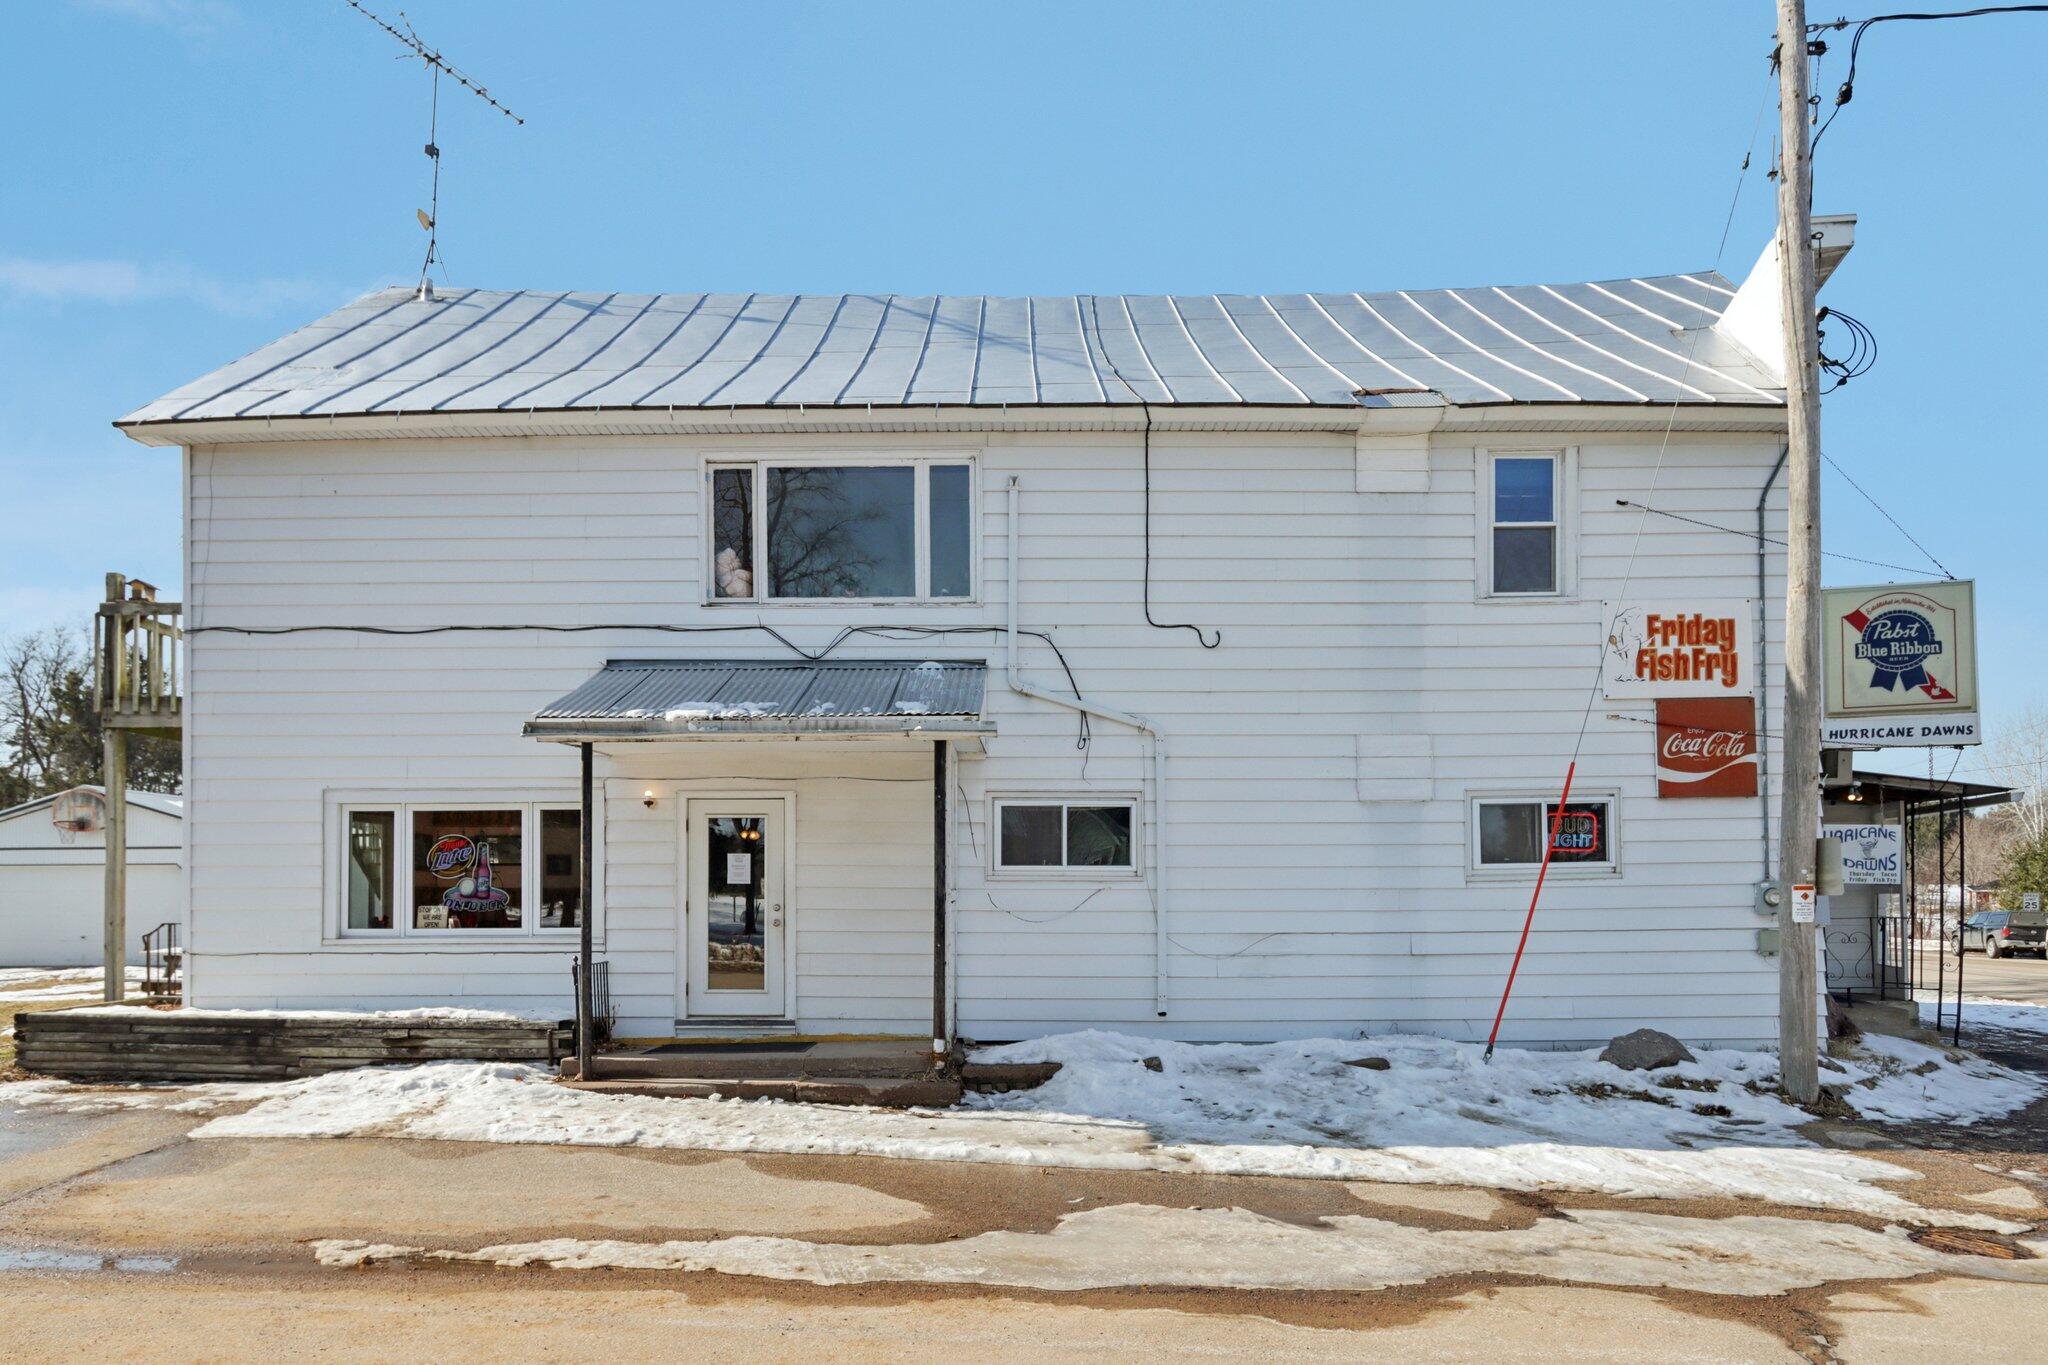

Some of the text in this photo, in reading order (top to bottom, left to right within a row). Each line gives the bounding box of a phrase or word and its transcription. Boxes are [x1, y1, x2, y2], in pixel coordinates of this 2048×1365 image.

[1646, 613, 1736, 652] Friday
[1870, 620, 1920, 639] Pabst
[1857, 641, 1940, 658] Blue Ribbon
[1828, 725, 1974, 740] HURRICANE DAWNS
[1551, 817, 1590, 834] BUD
[1823, 827, 1896, 843] URRICANE
[1843, 853, 1897, 871] DAWNS
[2025, 901, 2037, 909] 25
